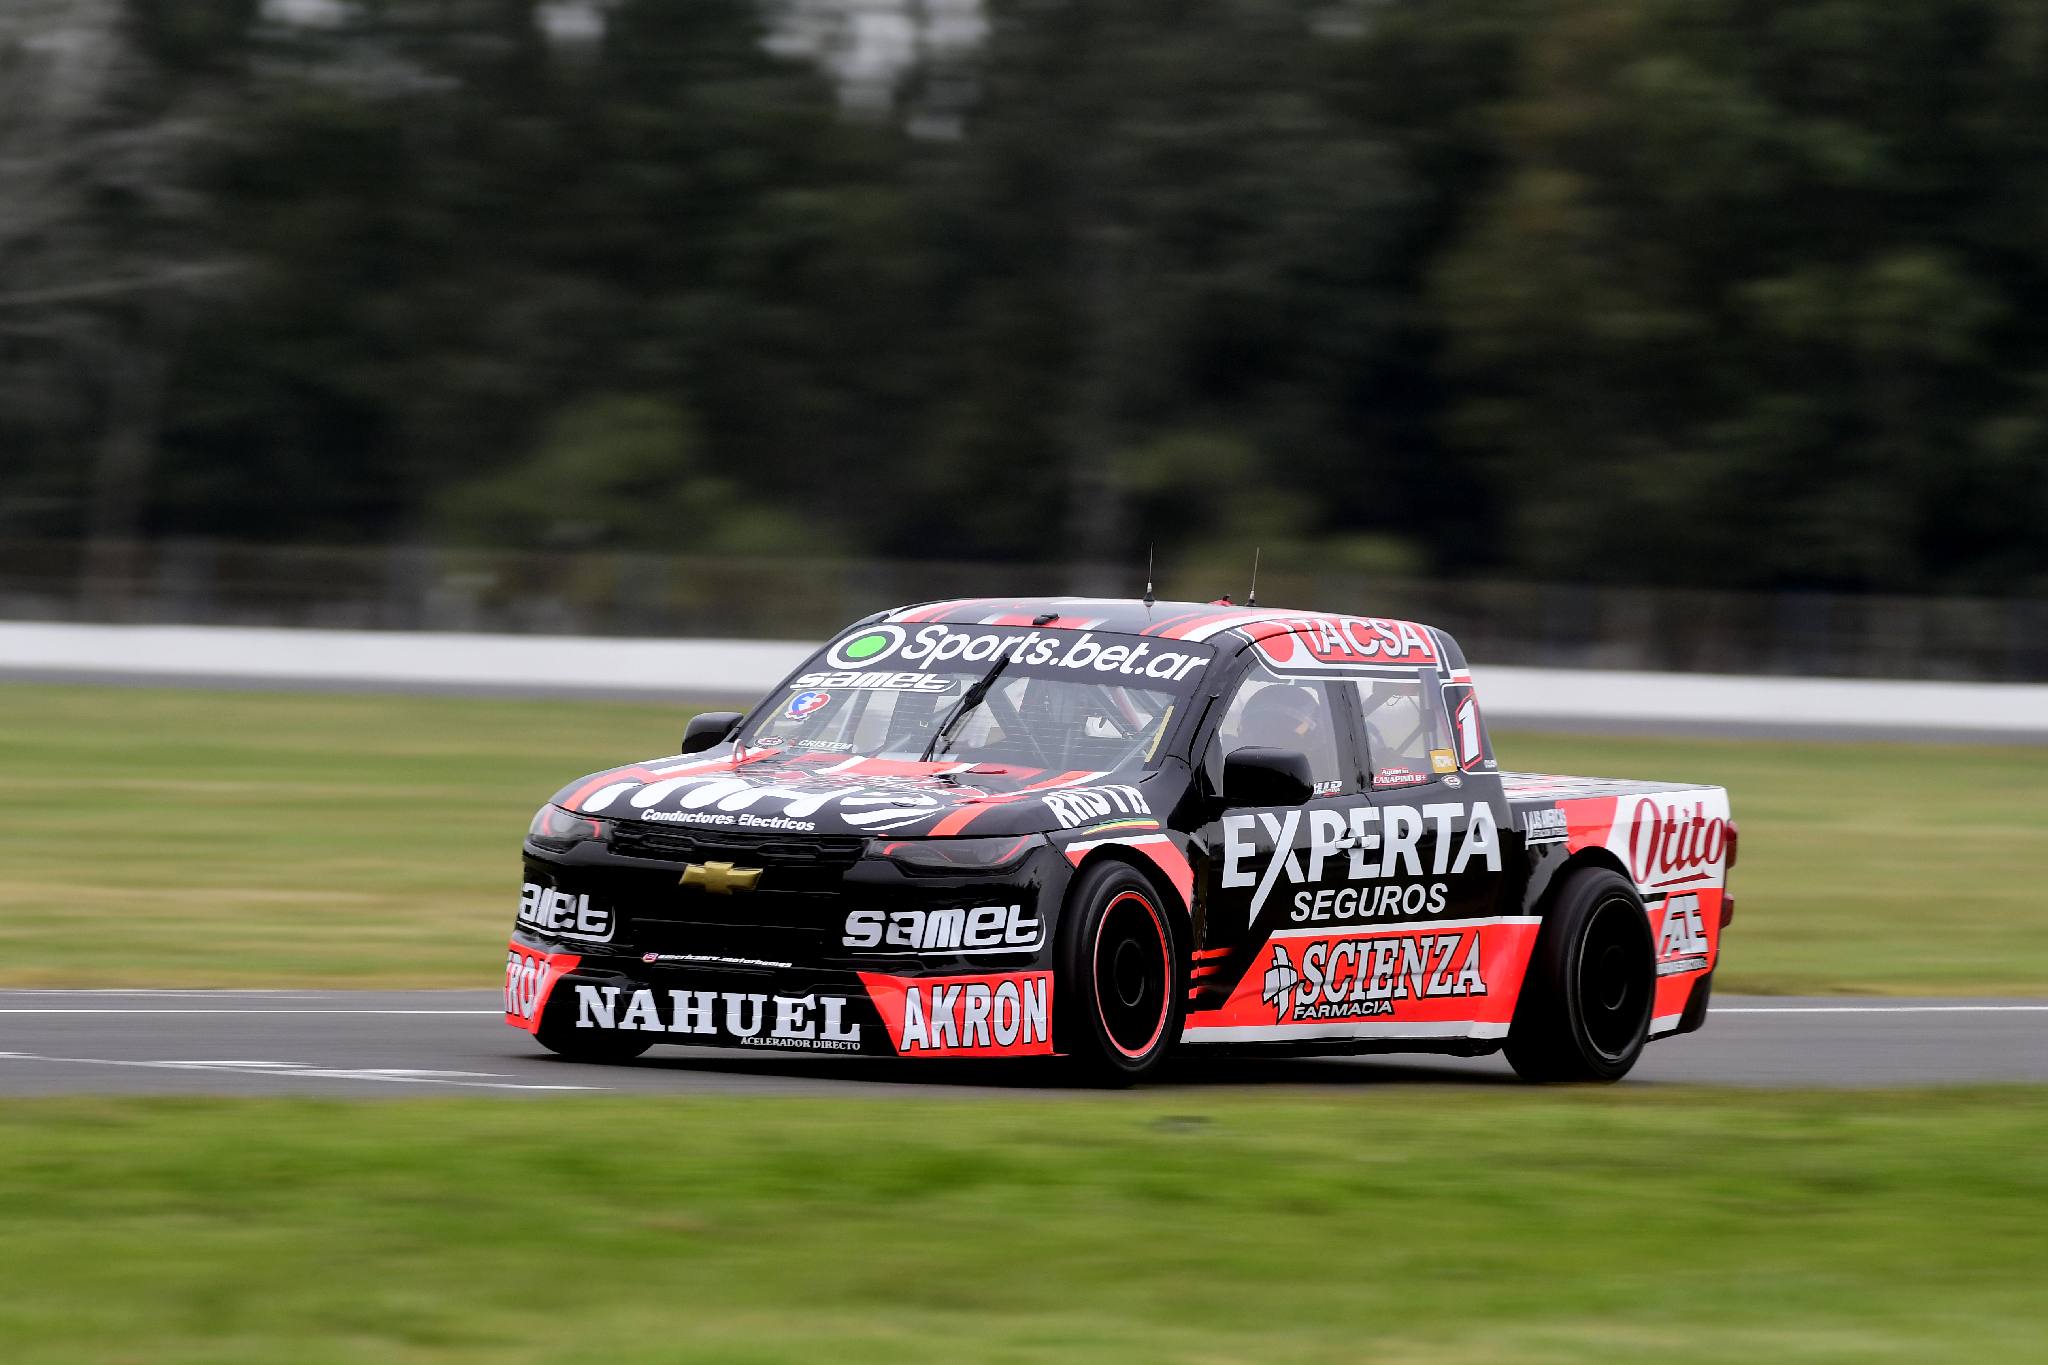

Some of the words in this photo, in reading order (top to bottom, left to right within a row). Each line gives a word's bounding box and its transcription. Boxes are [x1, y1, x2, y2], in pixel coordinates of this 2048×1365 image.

[790, 671, 954, 691] samet
[901, 624, 1210, 682] Sports.bet.ar
[1457, 699, 1481, 765] 1
[641, 808, 734, 826] Conductores
[738, 814, 816, 832] Electricos
[1629, 798, 1726, 884] Otito
[1222, 802, 1502, 930] EXPERTA
[842, 905, 1042, 952] samet
[1290, 883, 1448, 921] SEGUROS
[1295, 931, 1487, 1006] SCIENZA
[575, 985, 861, 1042] NAHUEL
[901, 977, 1047, 1050] AKRON
[1293, 1002, 1394, 1019] FARMACIA
[741, 1036, 811, 1048] ACELERADOR
[812, 1040, 861, 1051] DIRECTO
